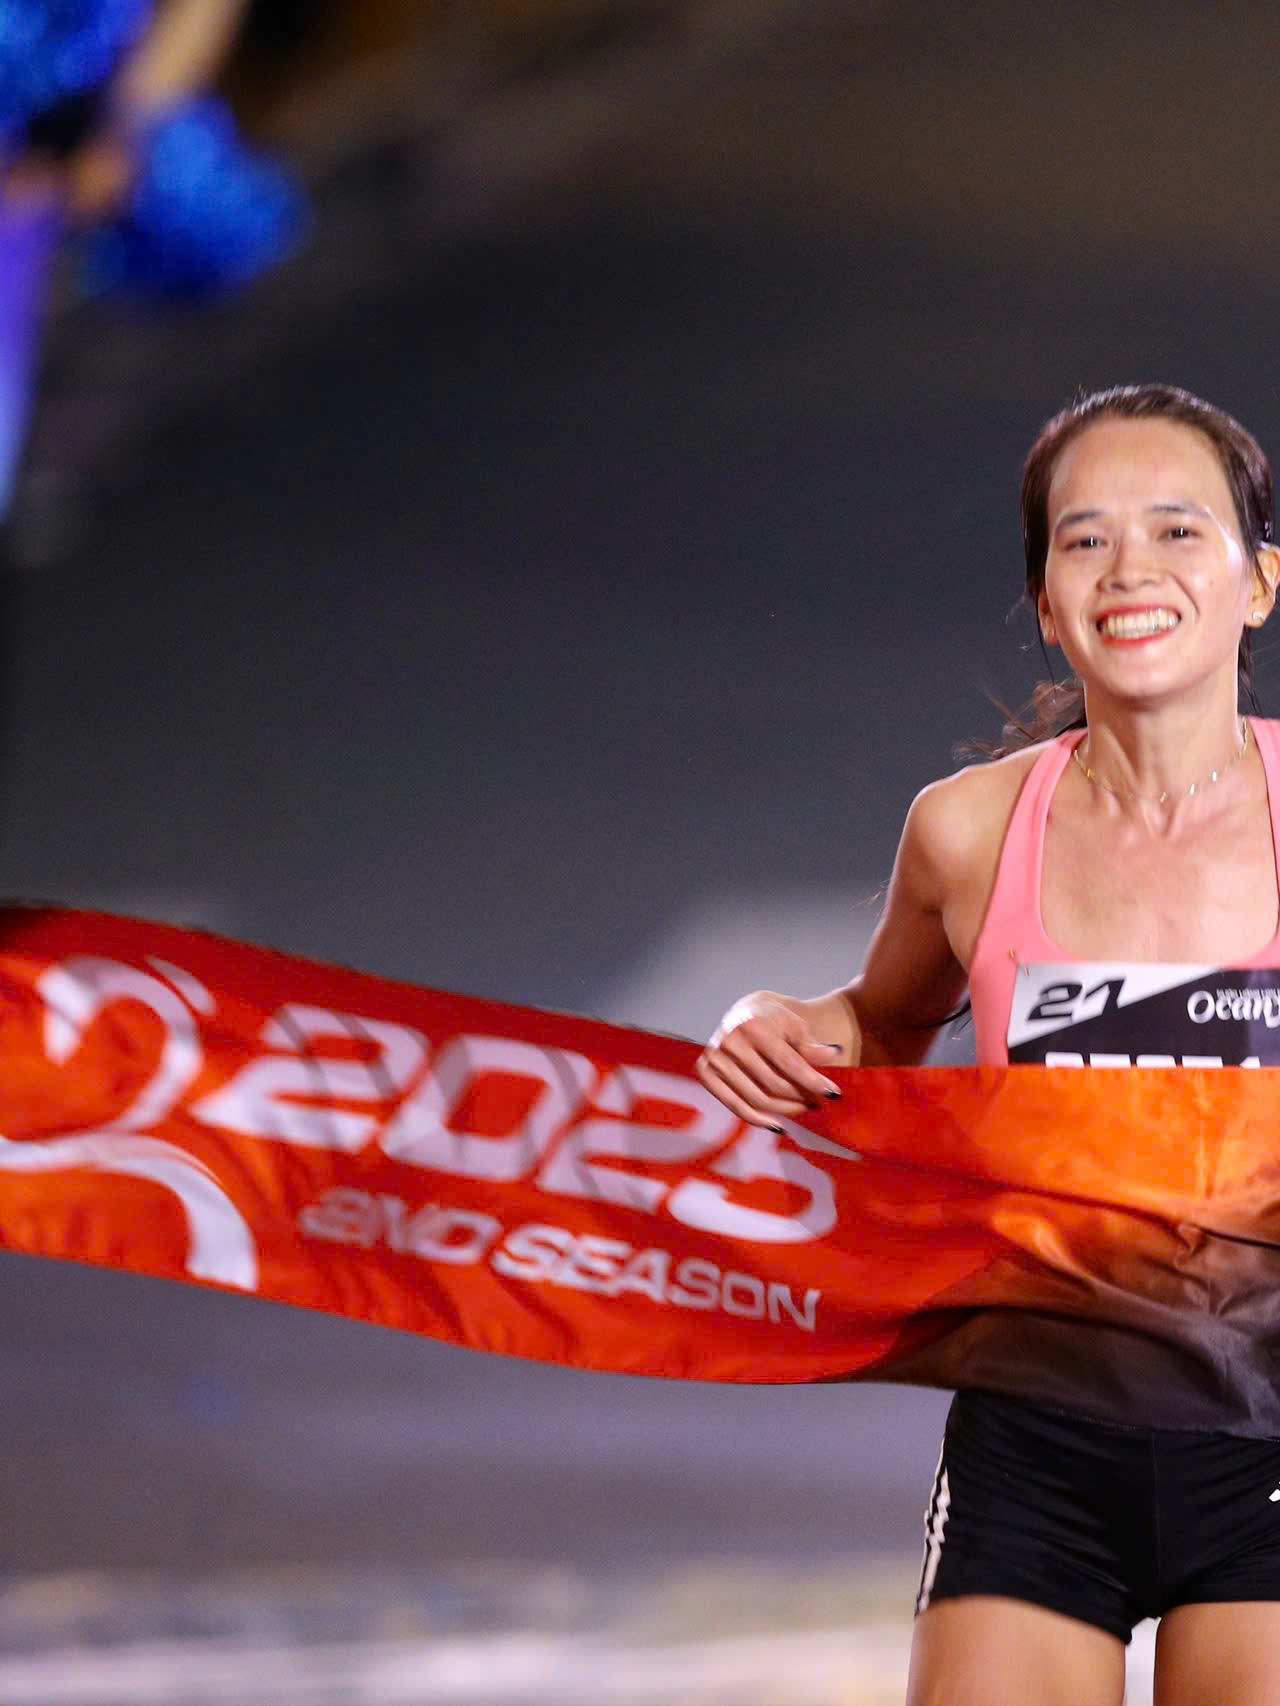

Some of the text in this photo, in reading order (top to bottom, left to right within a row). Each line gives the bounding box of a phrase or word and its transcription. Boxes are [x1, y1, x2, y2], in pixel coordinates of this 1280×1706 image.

[190, 1003, 862, 1244] 2025
[300, 1187, 822, 1332] 2ND SEASON
